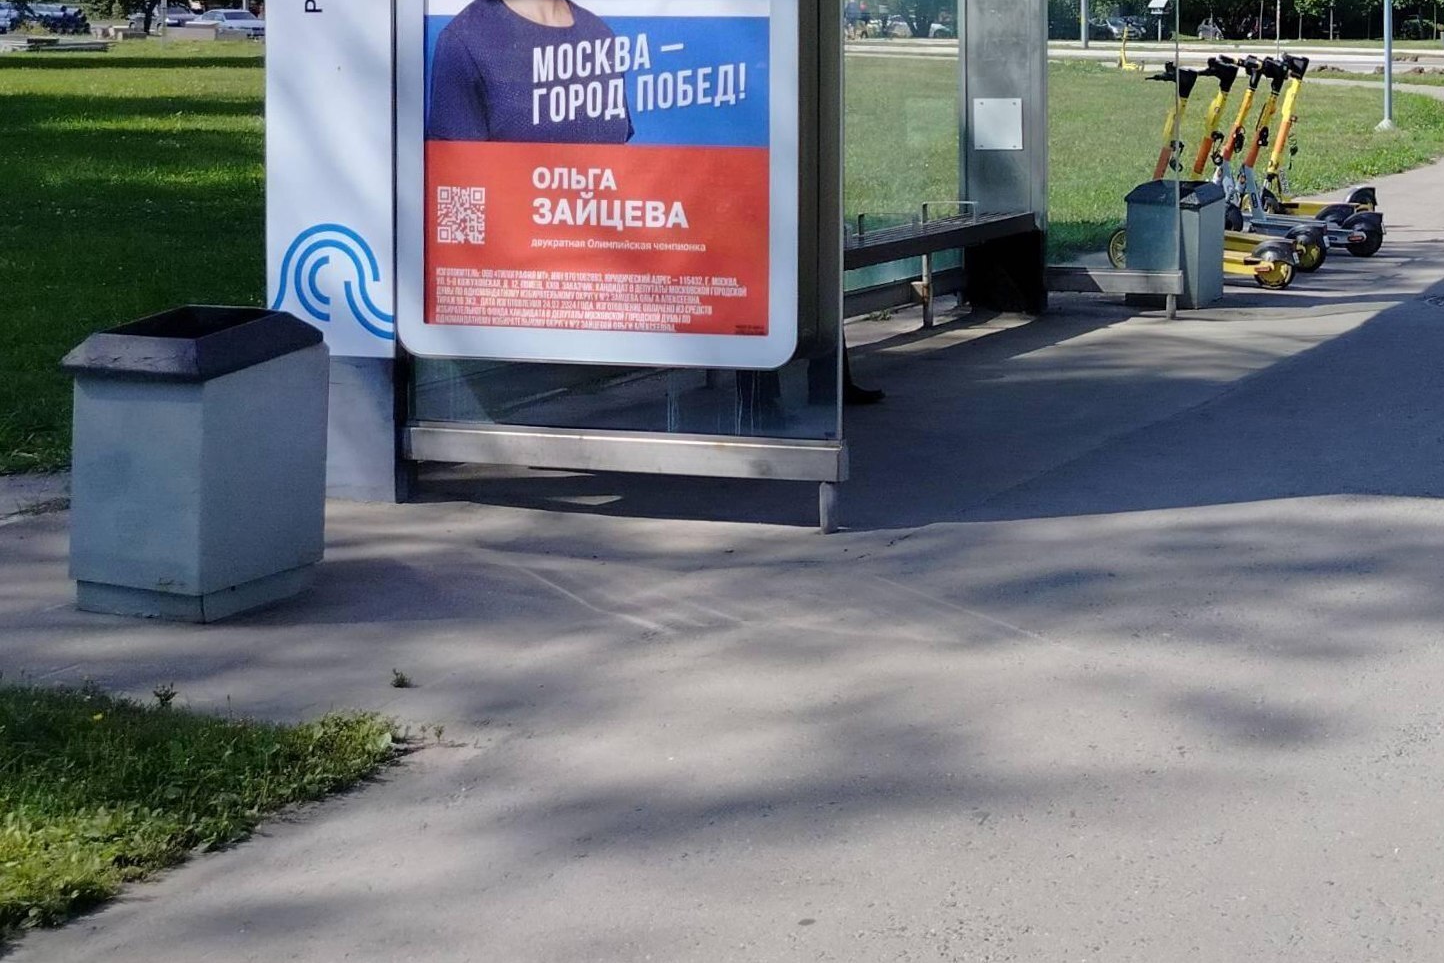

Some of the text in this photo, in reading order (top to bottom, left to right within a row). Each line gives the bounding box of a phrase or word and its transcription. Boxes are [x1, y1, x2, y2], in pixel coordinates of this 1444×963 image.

[532, 33, 651, 83] МОСКВА
[532, 62, 747, 125] ГОРОД ПОБЕД!
[532, 166, 617, 191] ОЛЬГА
[532, 192, 689, 231] ЗАЙЦЕВА
[531, 238, 707, 253] двукратная Олимпийская чемпионка
